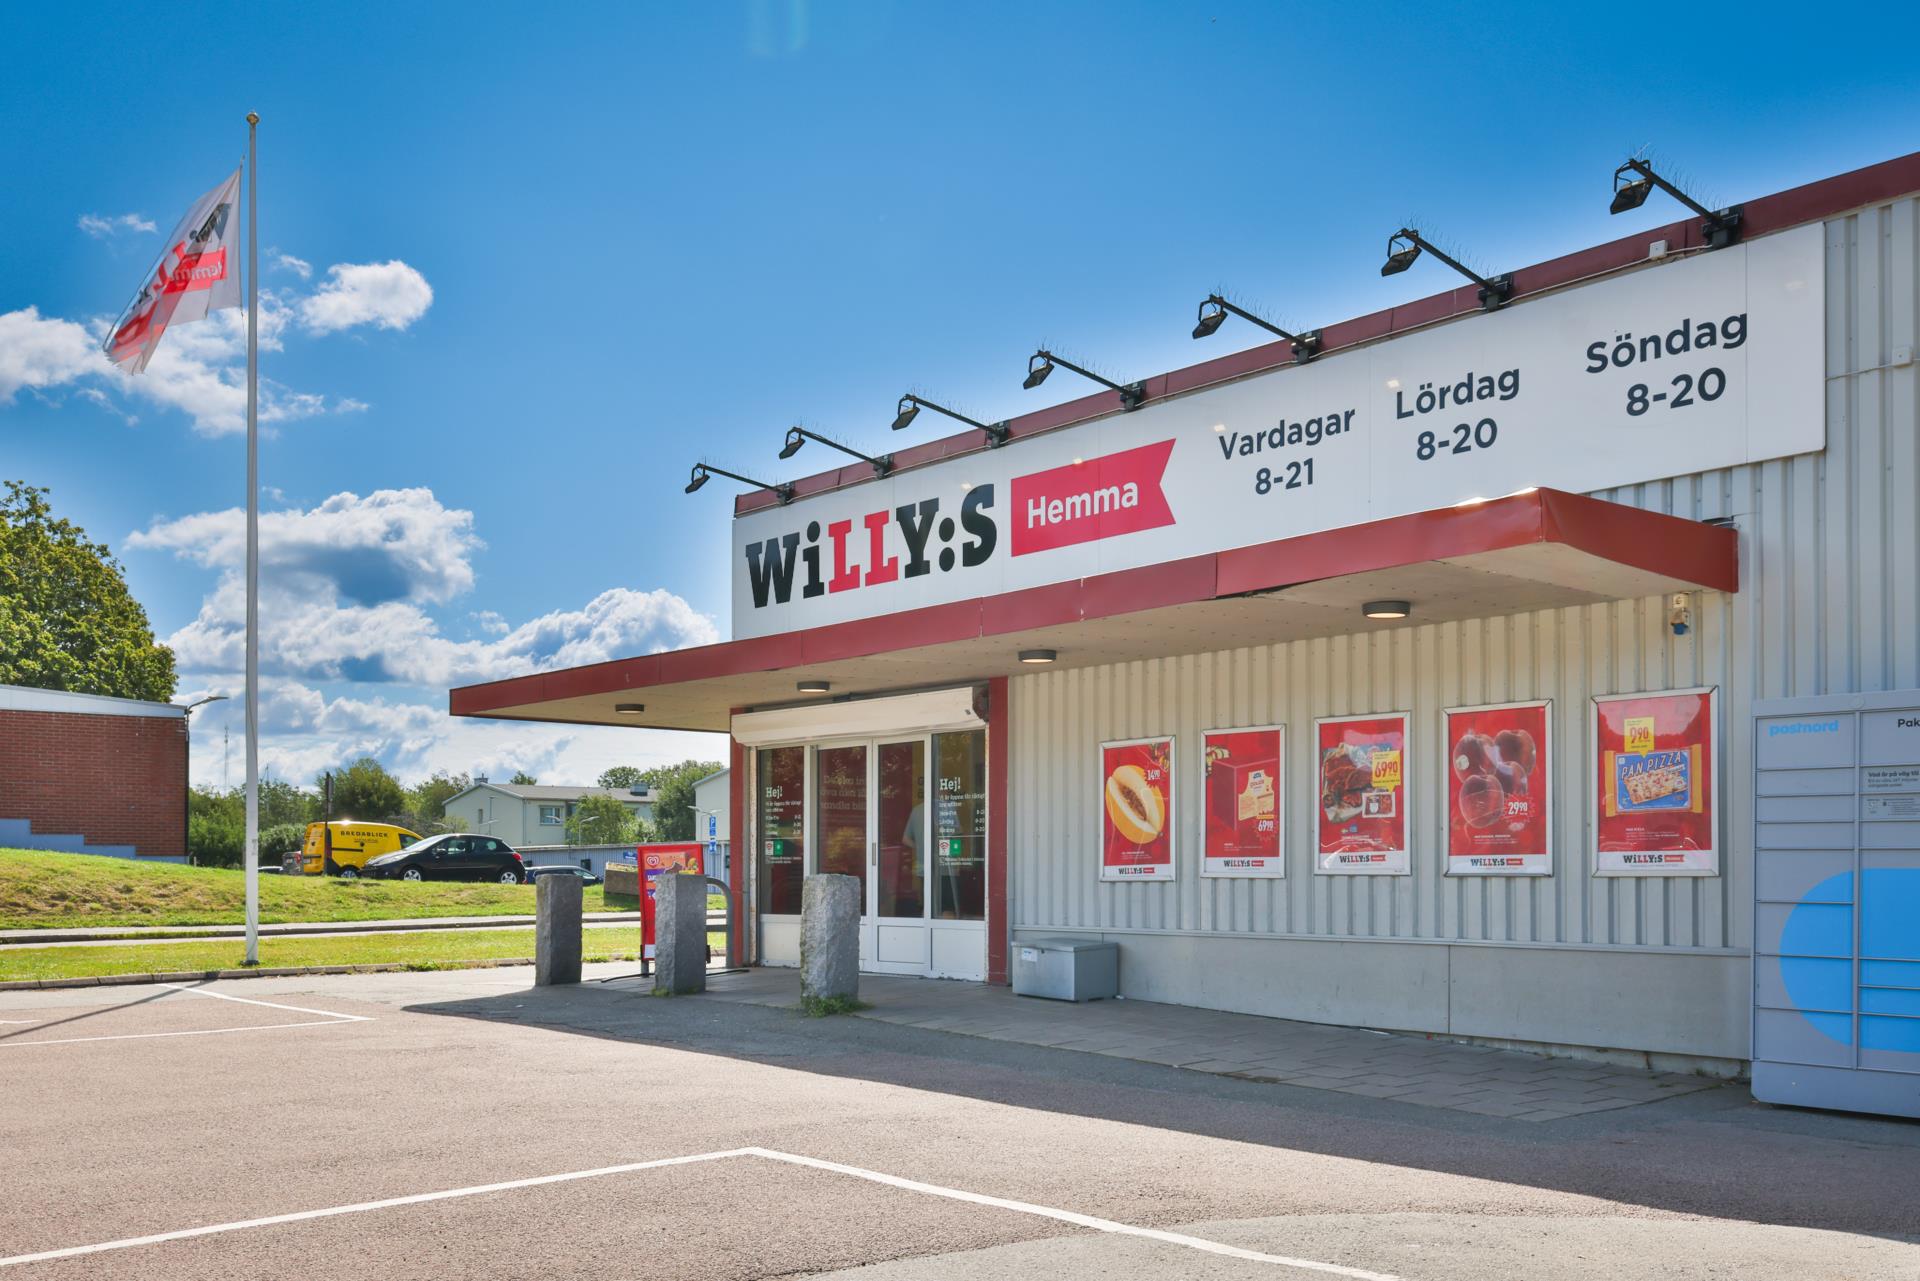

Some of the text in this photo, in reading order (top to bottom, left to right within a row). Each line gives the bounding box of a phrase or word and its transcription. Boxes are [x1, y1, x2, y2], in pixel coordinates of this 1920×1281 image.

[1585, 313, 1749, 374] Söndag
[1395, 368, 1520, 419] Lördag
[1625, 367, 1727, 416] 8-20
[1219, 408, 1356, 460] Vardagar
[1416, 418, 1498, 461] 8-20
[1255, 458, 1315, 495] 8-21
[1027, 482, 1138, 529] Hemma
[1769, 719, 1839, 737] postnord
[939, 777, 961, 792] Hej!
[1622, 762, 1643, 779] PAN
[1647, 751, 1681, 771] PIZZA
[766, 785, 783, 799] Hej!
